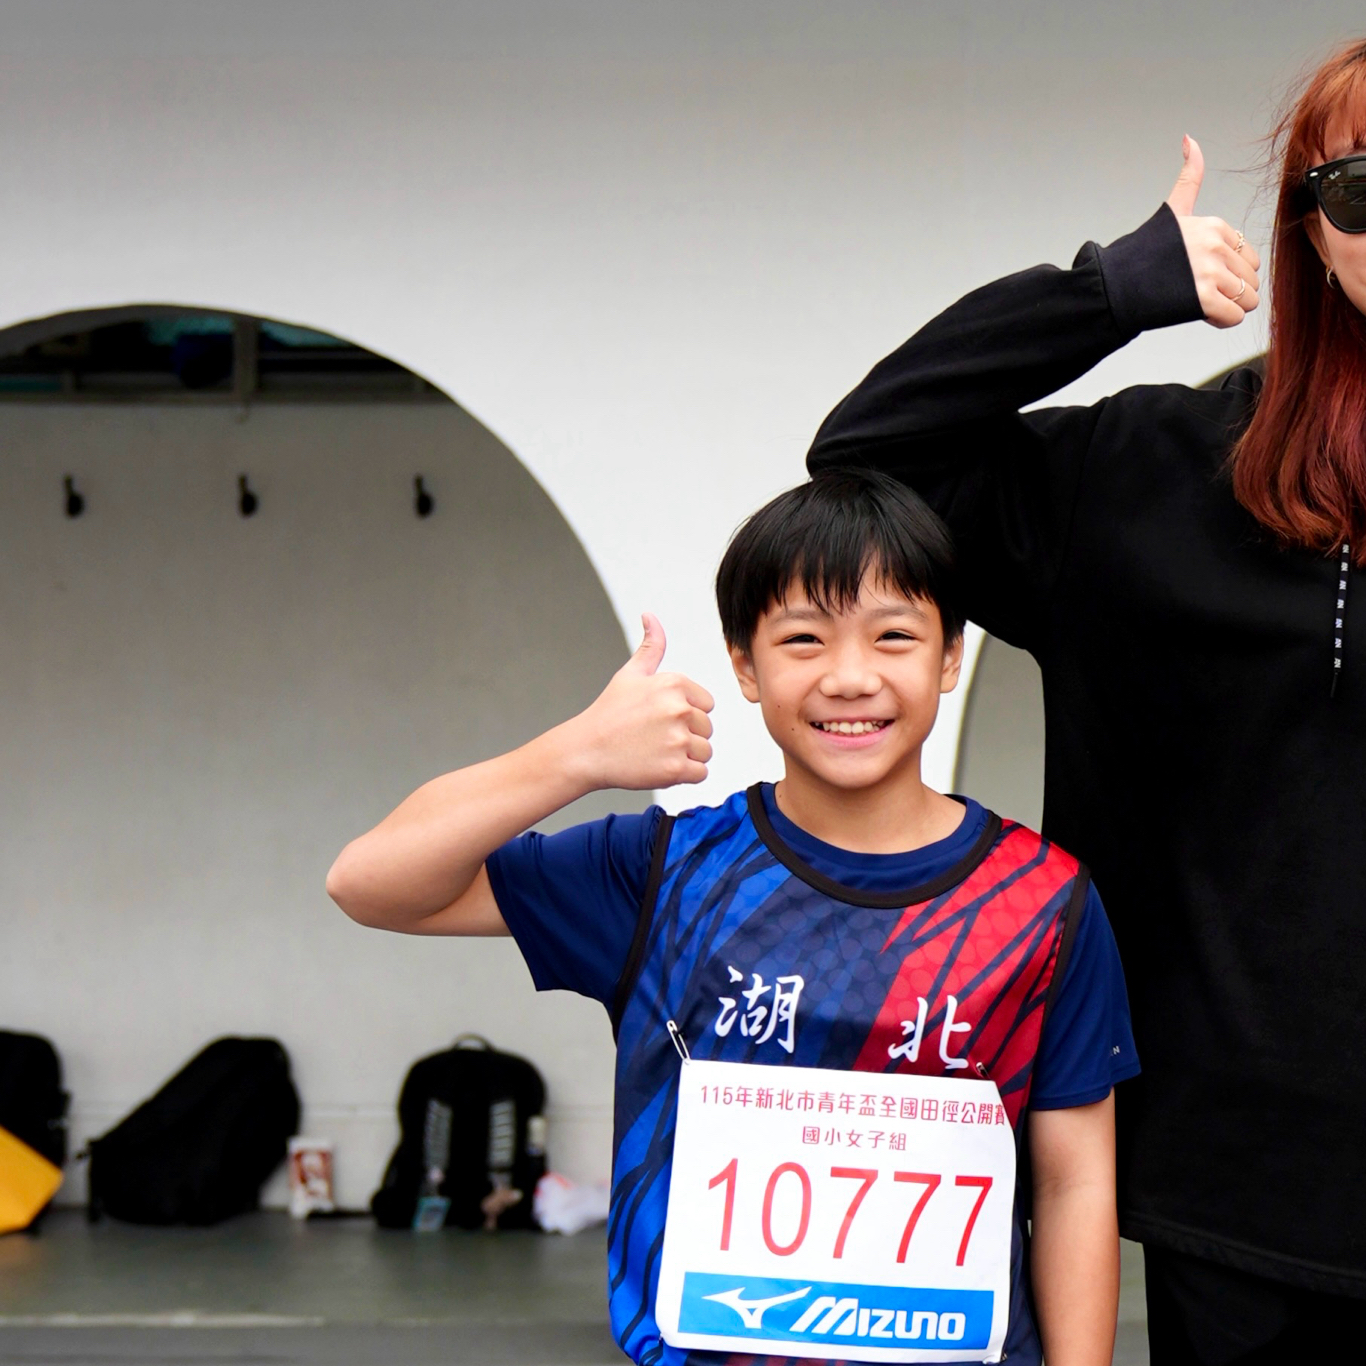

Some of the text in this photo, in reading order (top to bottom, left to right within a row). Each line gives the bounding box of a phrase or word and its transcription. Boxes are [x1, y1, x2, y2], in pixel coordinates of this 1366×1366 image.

[714, 965, 974, 1070] 湖北
[801, 1125, 908, 1152] 國小女子組
[707, 1158, 994, 1267] 10777
